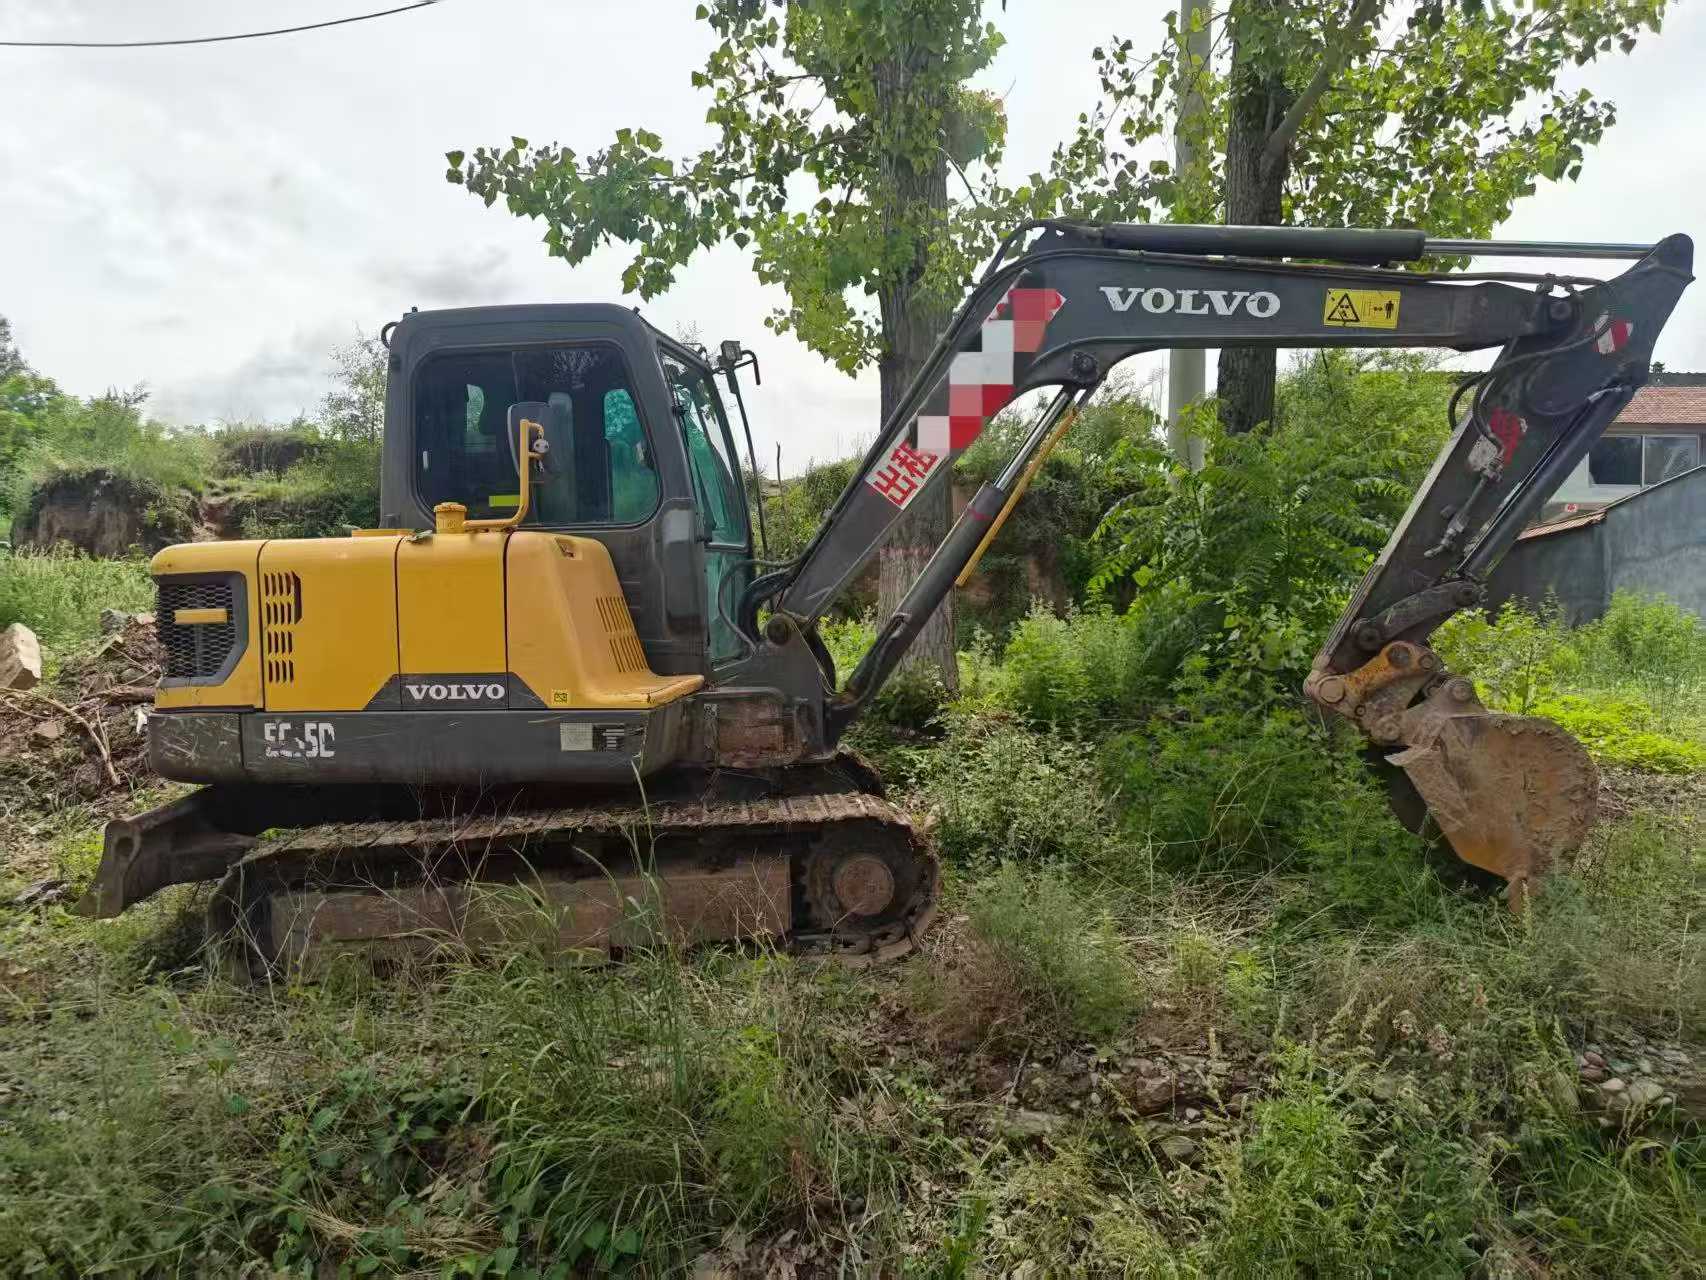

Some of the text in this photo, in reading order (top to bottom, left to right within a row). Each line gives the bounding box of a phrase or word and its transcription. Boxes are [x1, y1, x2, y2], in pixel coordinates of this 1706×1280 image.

[1099, 286, 1281, 318] VOLVO
[873, 441, 938, 506] 出租
[405, 683, 506, 701] VOLVO
